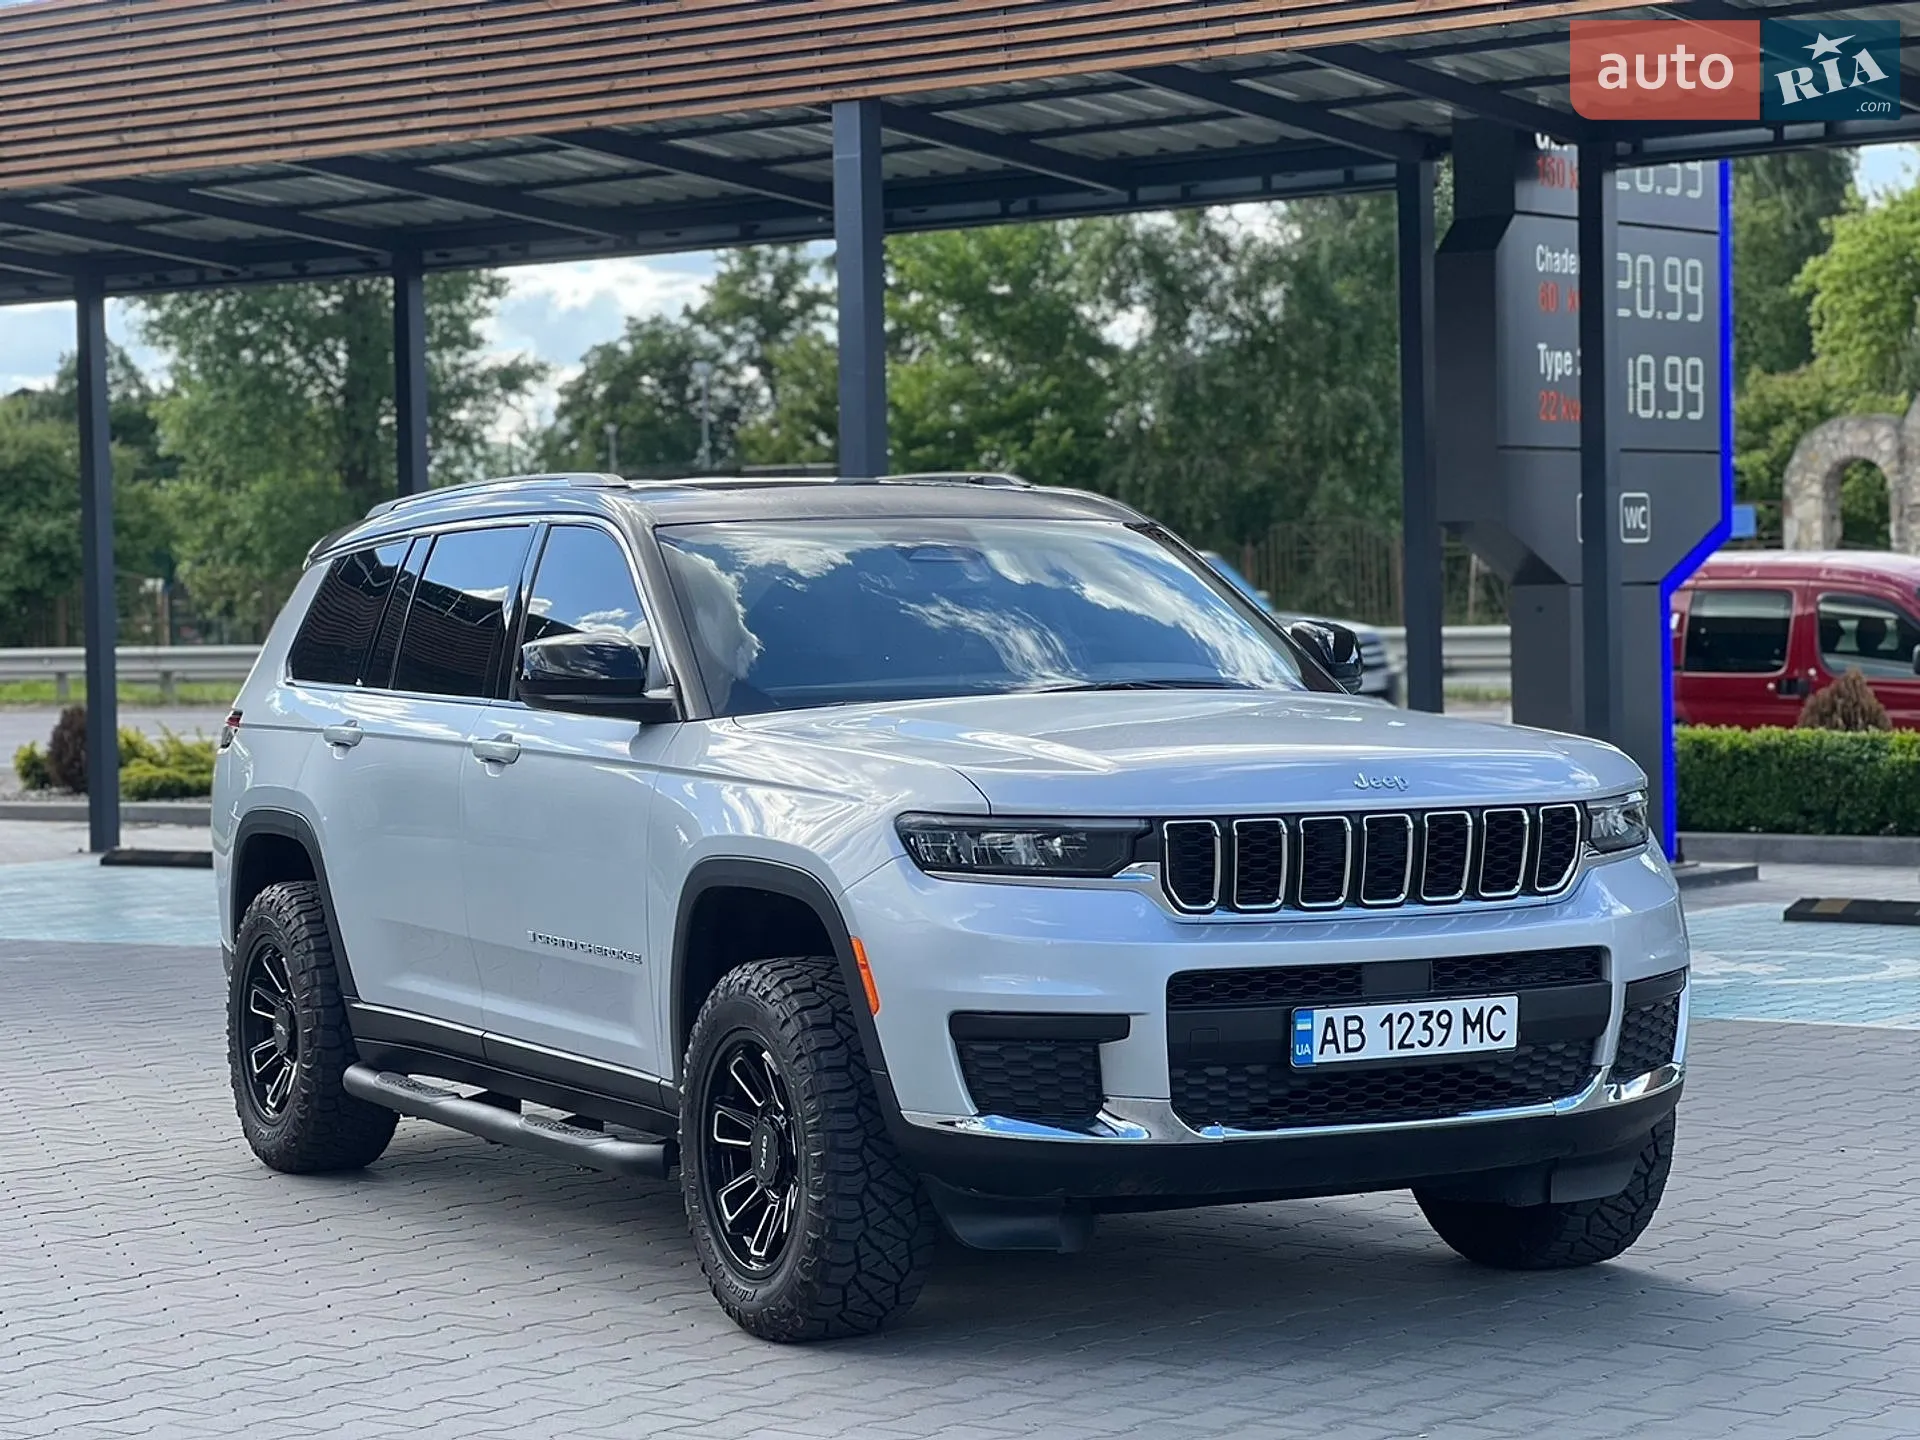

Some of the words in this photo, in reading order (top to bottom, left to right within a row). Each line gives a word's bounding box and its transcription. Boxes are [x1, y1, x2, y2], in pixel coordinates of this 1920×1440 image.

[1535, 243, 1579, 274] Chade
[1615, 252, 1704, 322] 20.99
[1536, 342, 1573, 382] Type
[1628, 354, 1704, 420] 18.99
[1539, 390, 1558, 421] 22
[1624, 506, 1648, 530] WC
[1353, 772, 1409, 792] Jeep
[1318, 1014, 1366, 1056] AB
[1379, 1009, 1453, 1051] 1239
[1462, 1004, 1507, 1046] MC
[1296, 1042, 1311, 1056] UA
